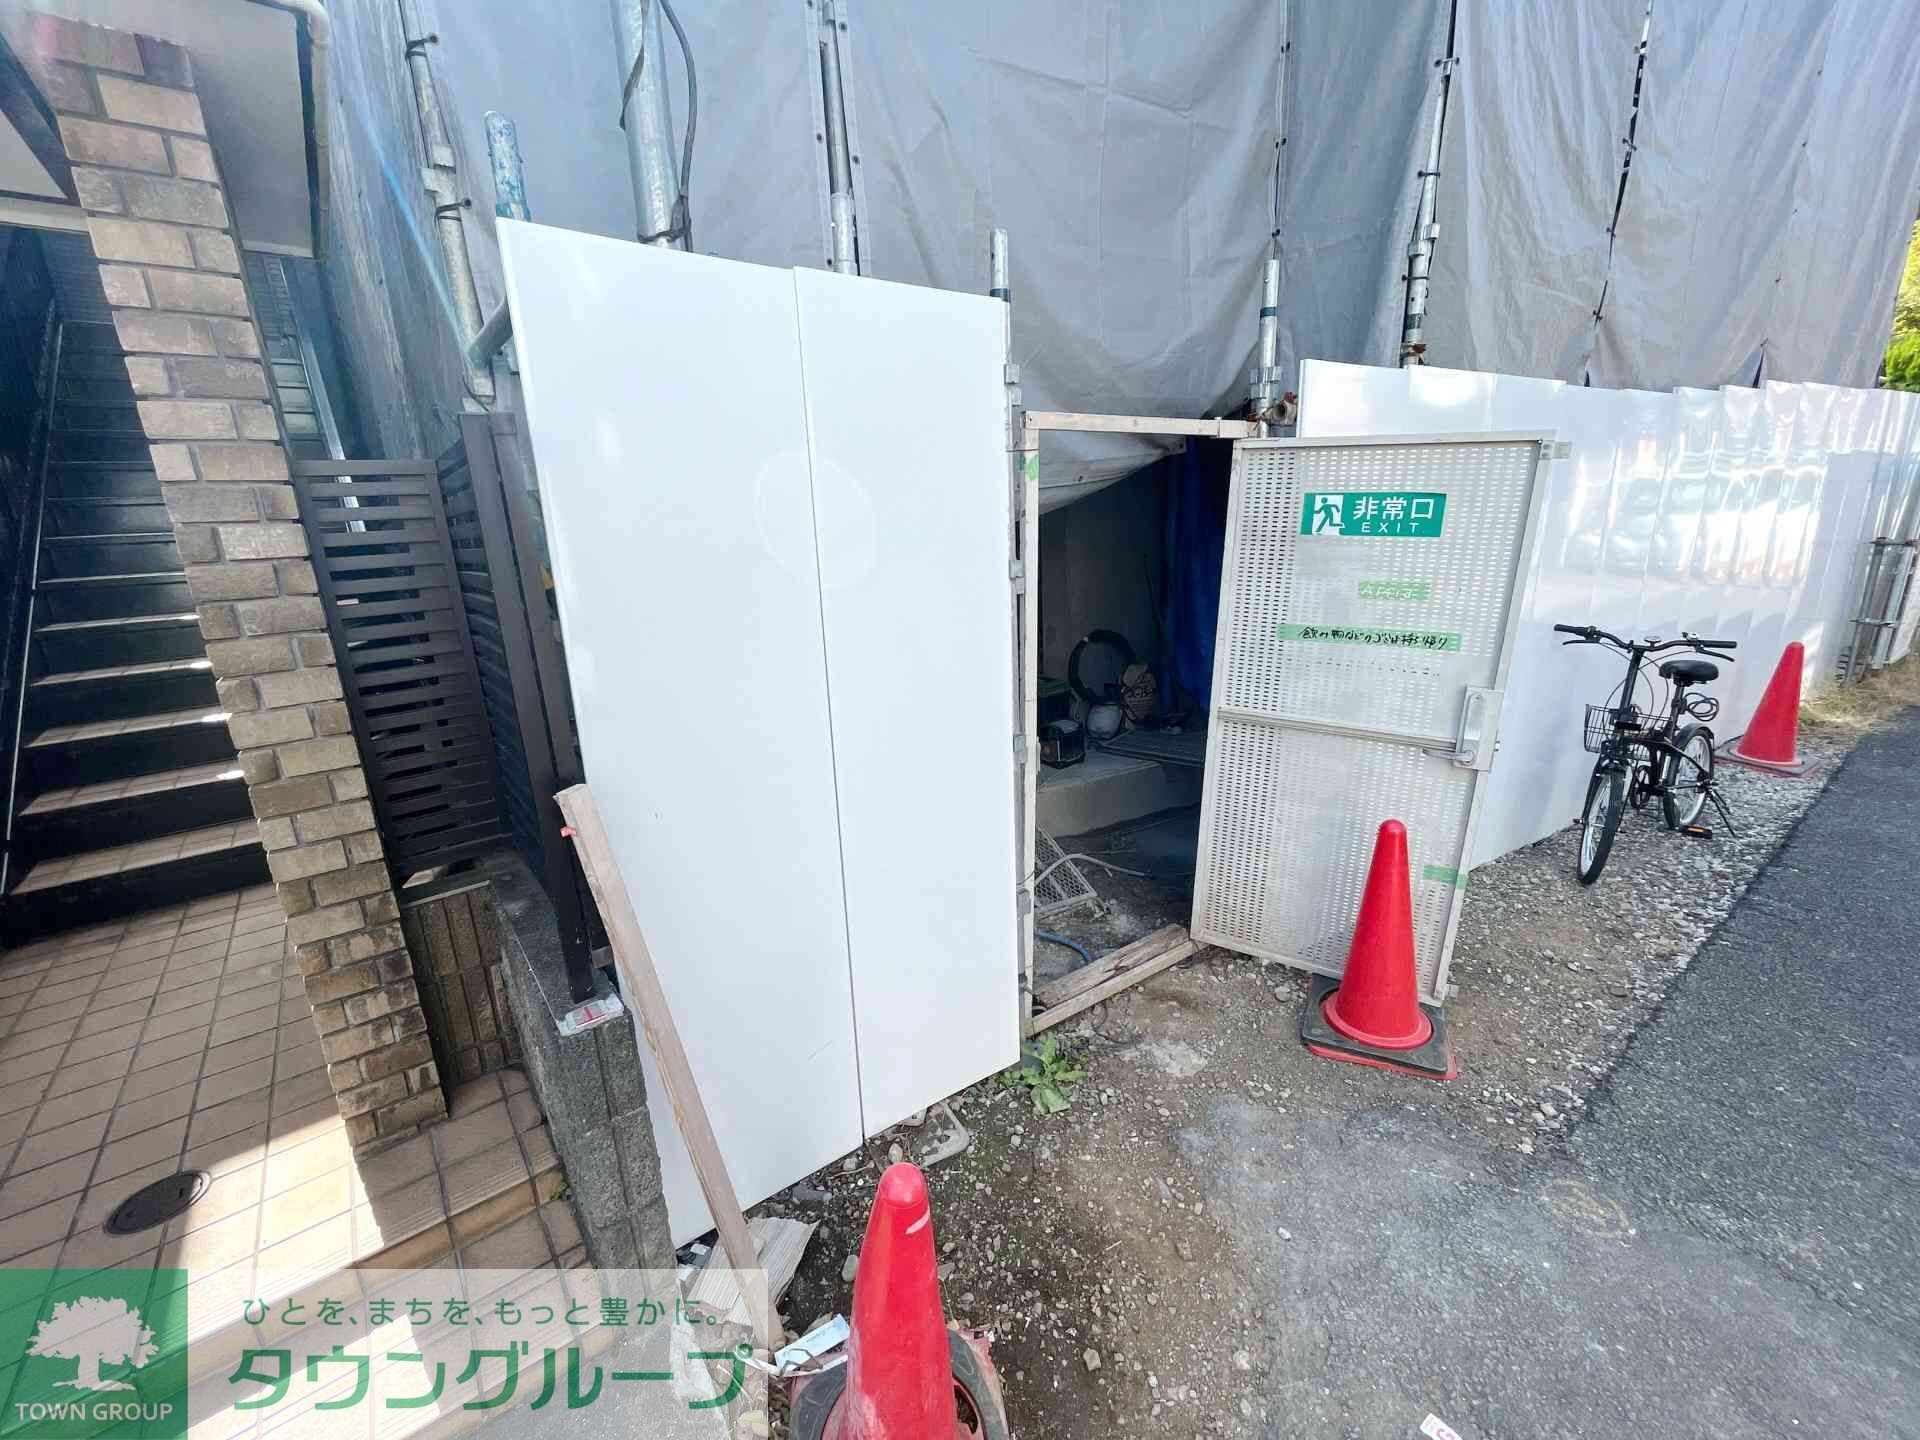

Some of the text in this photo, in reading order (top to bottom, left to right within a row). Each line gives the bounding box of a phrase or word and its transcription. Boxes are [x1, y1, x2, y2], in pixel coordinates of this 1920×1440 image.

[1353, 497, 1434, 521] 非常口
[1362, 522, 1420, 534] EXIT
